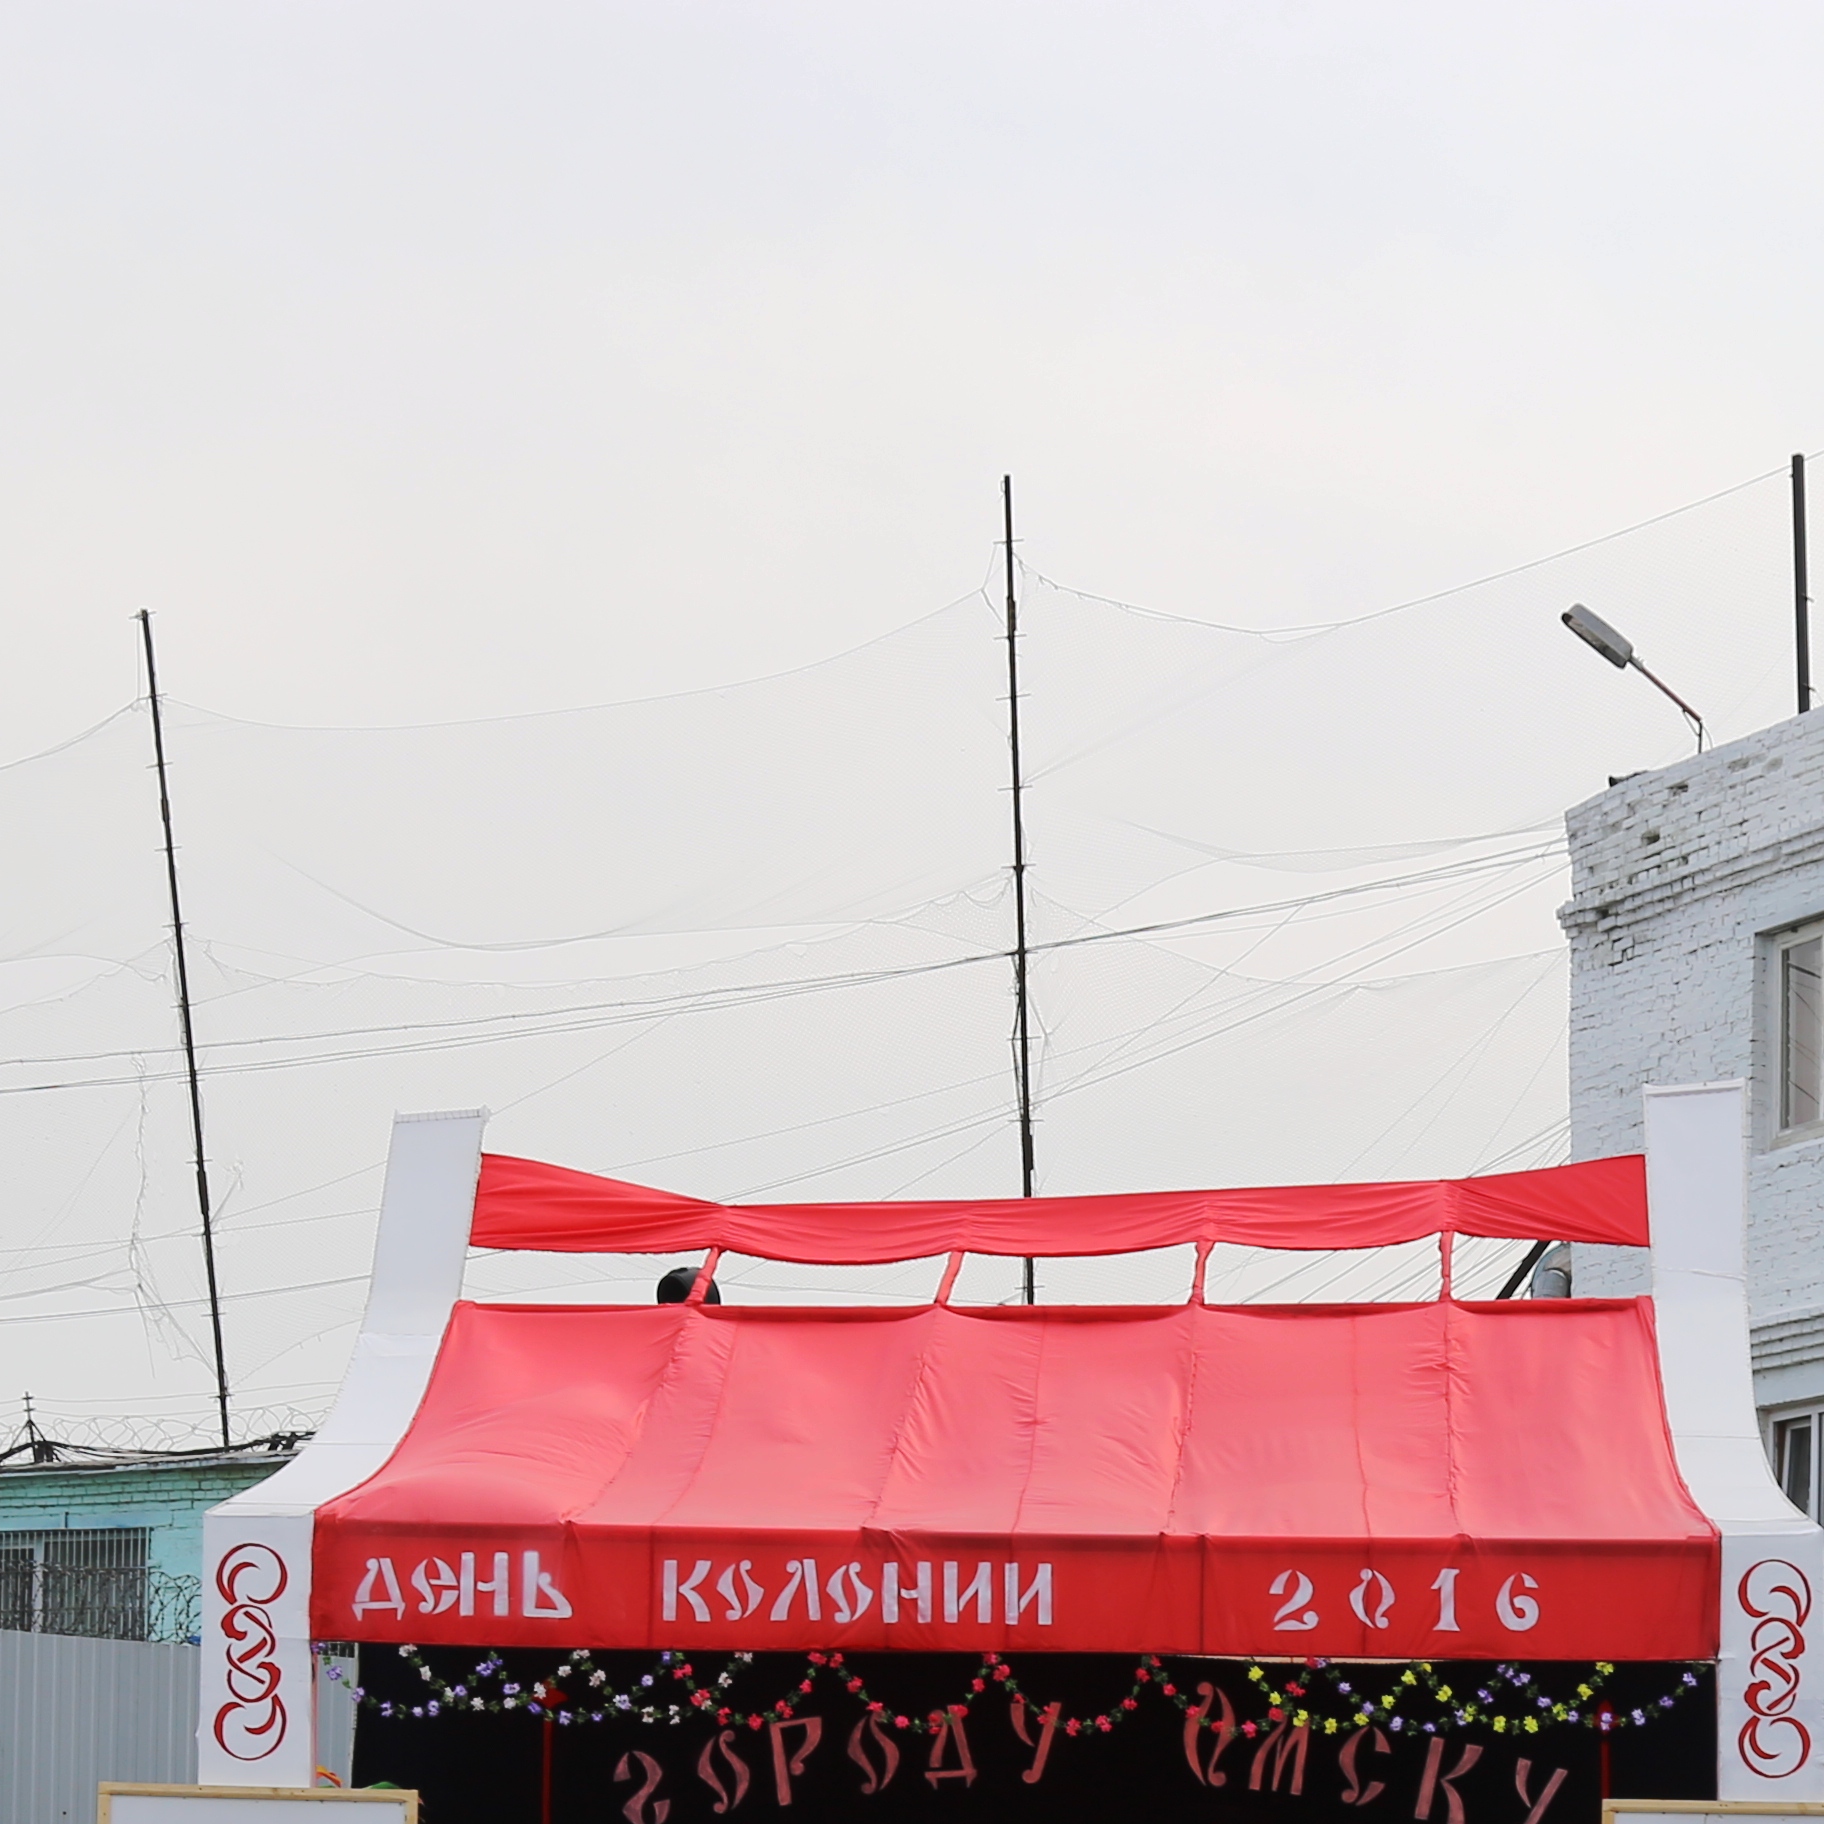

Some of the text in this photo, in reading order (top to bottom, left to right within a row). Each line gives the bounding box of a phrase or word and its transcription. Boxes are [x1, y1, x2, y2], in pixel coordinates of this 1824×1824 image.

[351, 1550, 1542, 1633] ДЕНЬ КОЛОНИИ 2016
